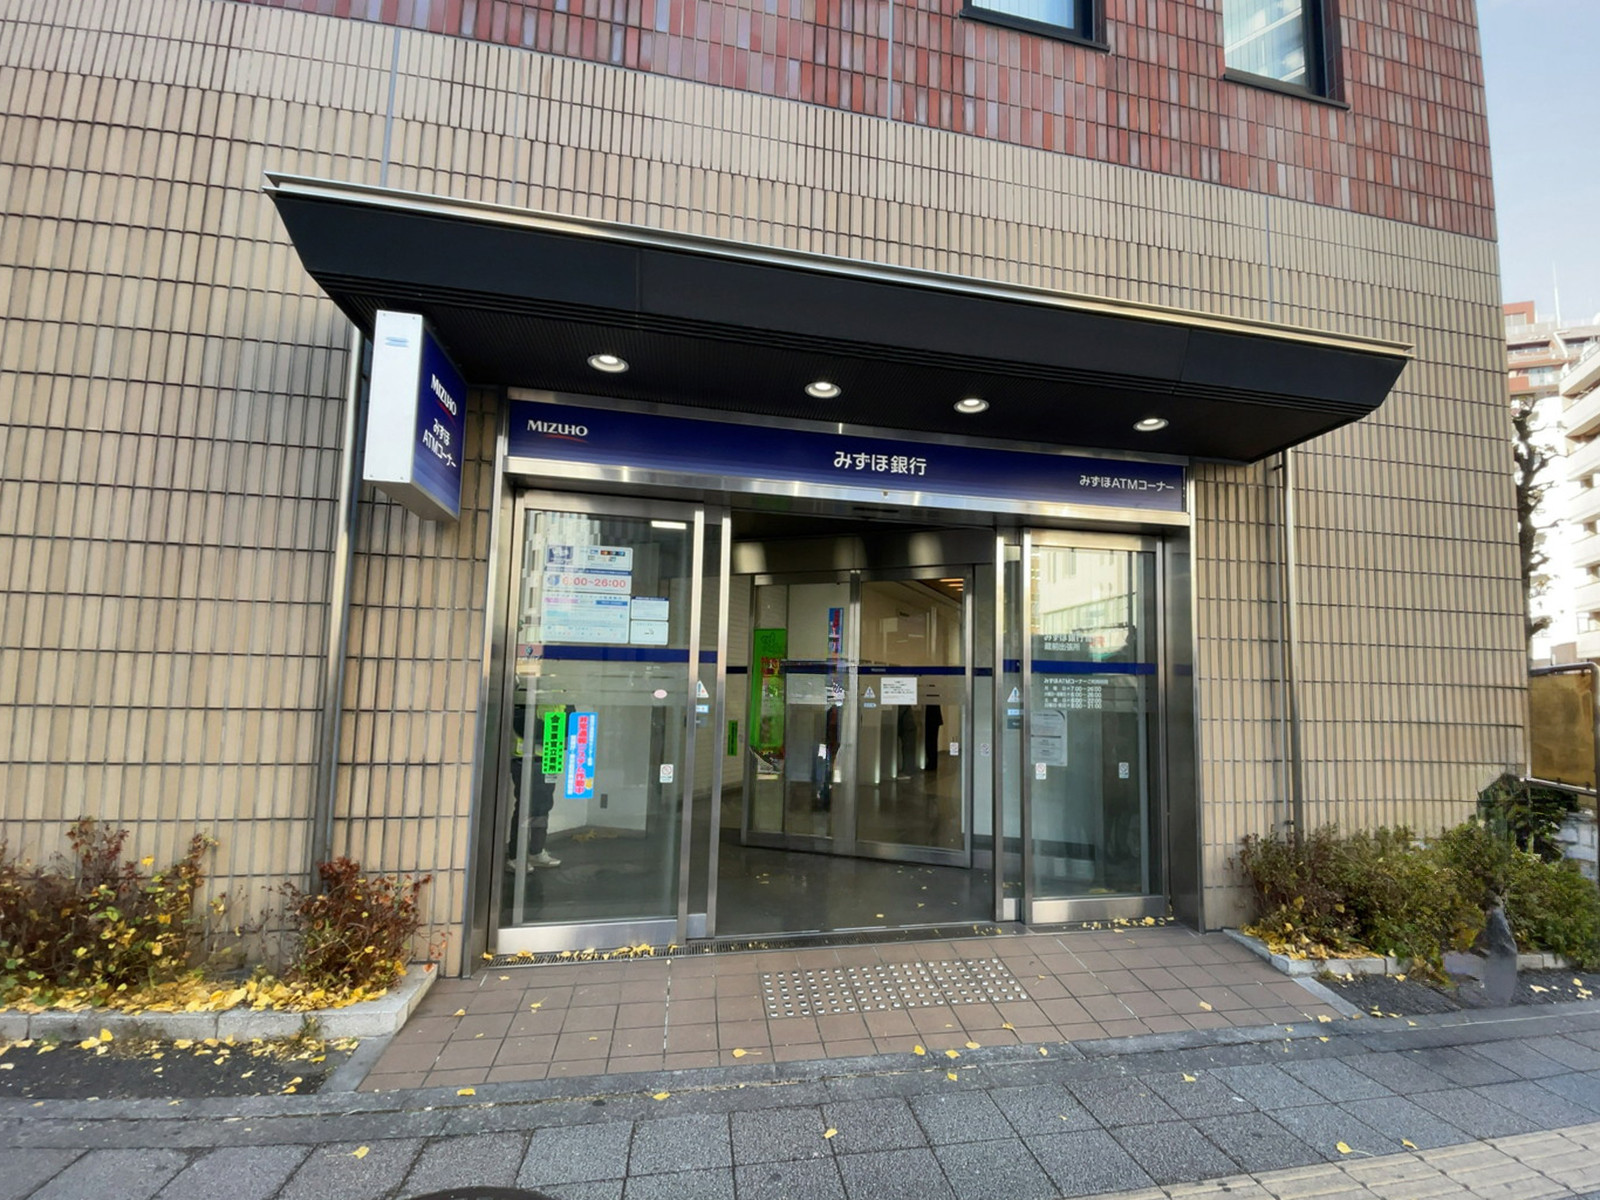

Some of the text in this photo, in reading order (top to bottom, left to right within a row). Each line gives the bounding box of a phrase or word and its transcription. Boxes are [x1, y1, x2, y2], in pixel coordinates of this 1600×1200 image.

[431, 373, 457, 416] MIZUHO
[433, 418, 451, 446] みずほ
[527, 419, 588, 437] MIZUHO
[422, 429, 457, 468] ATMコーナー
[833, 450, 927, 476] みずほ銀行
[1079, 474, 1175, 492] みずほATMコーナー
